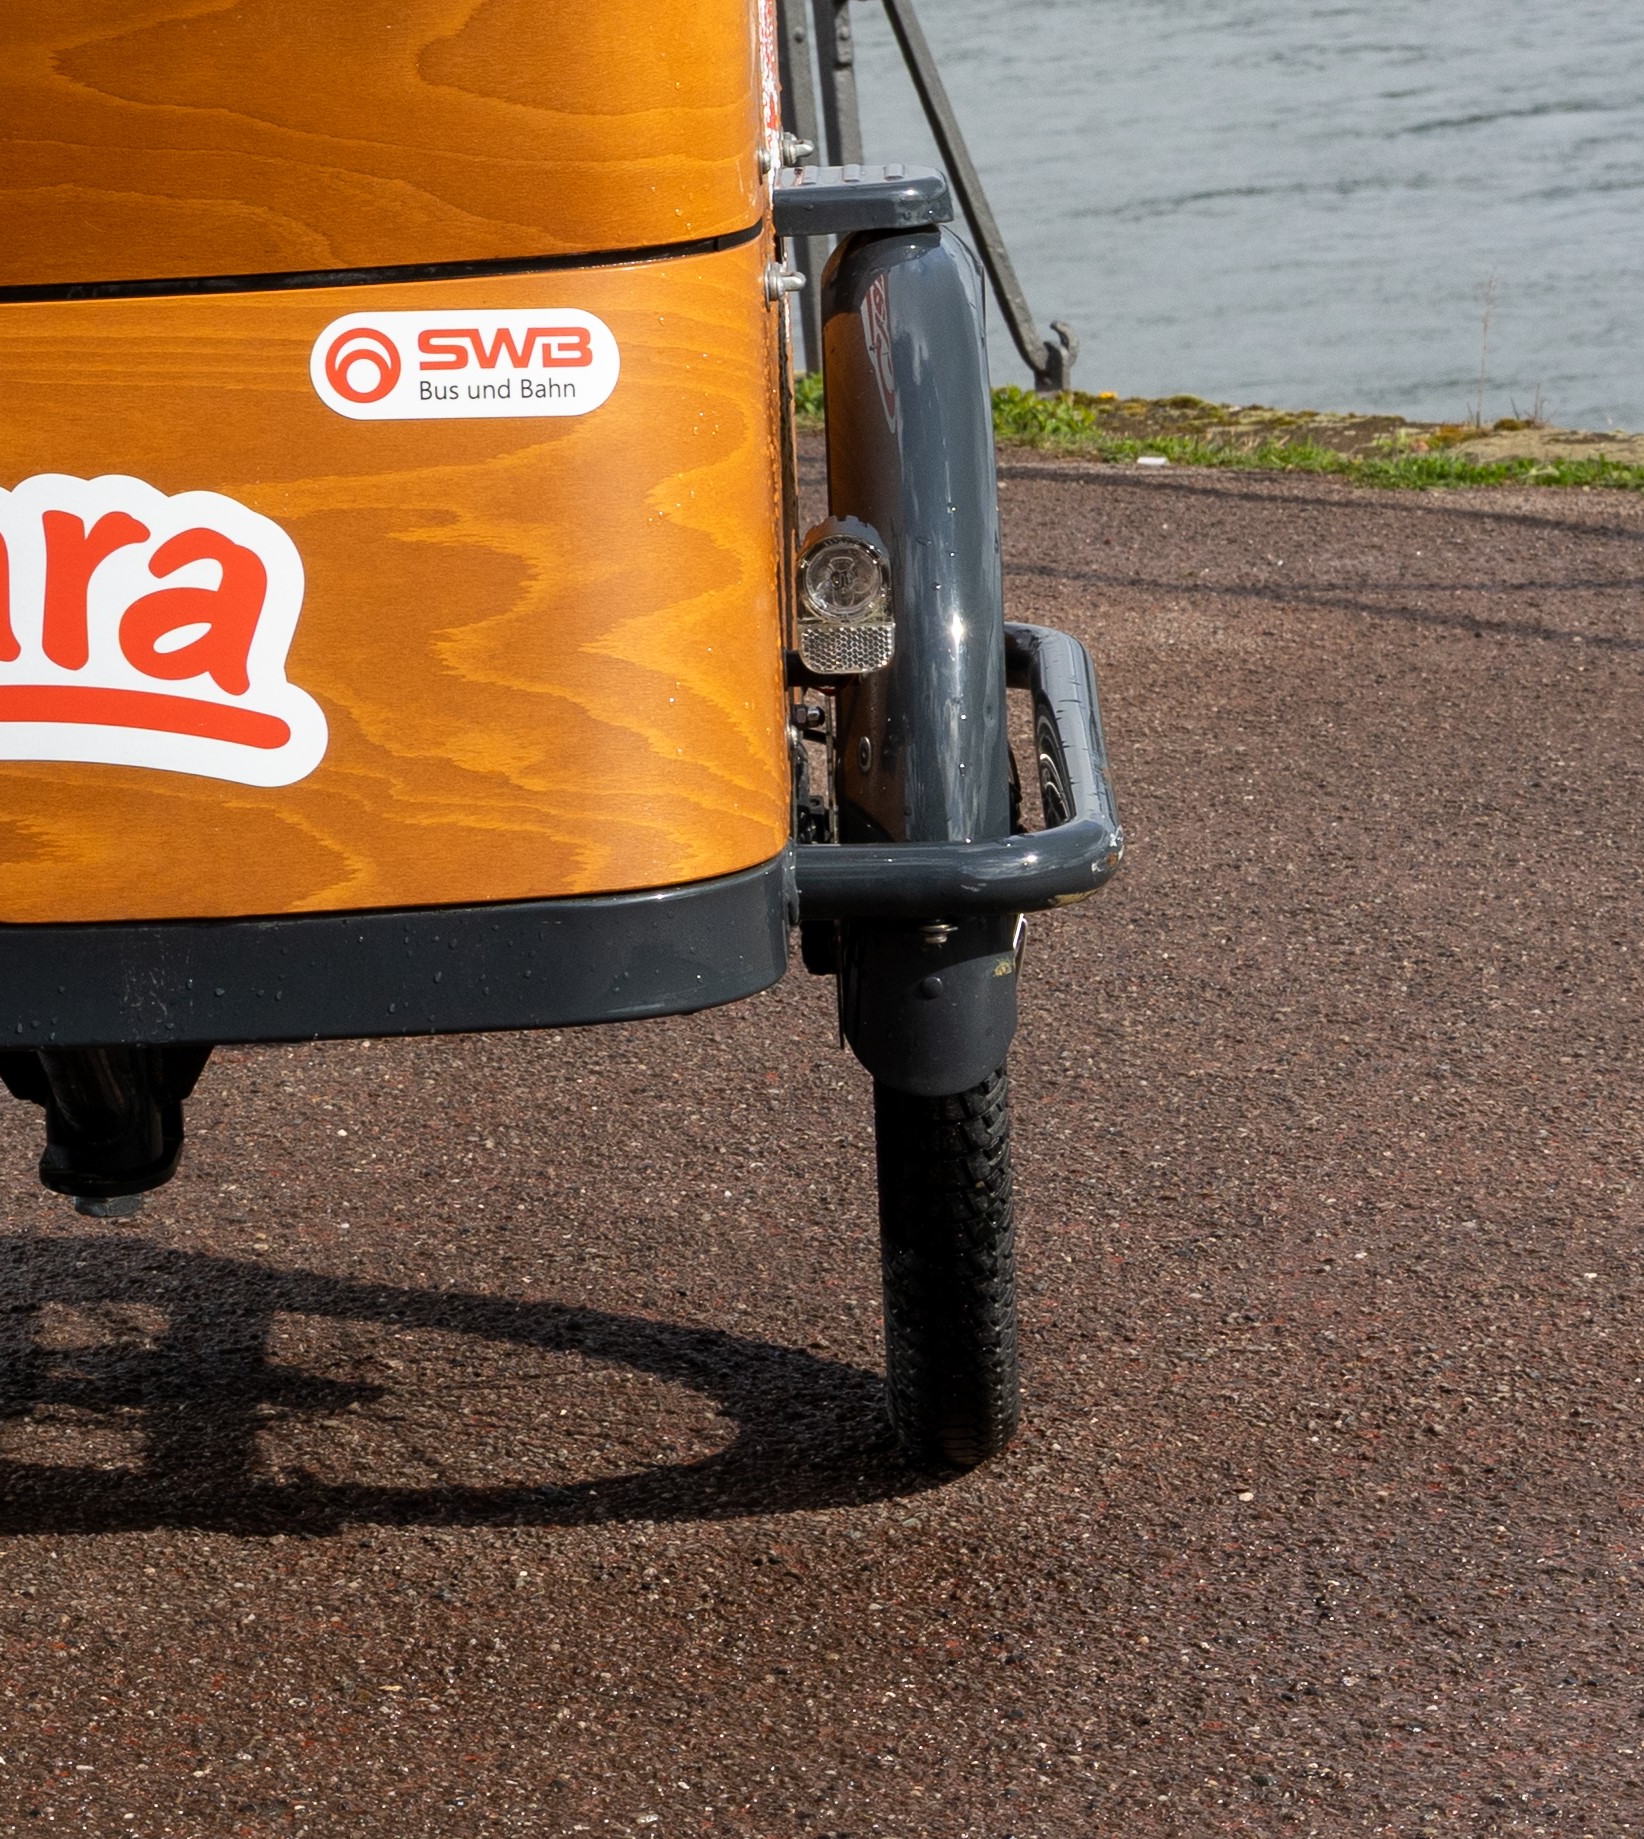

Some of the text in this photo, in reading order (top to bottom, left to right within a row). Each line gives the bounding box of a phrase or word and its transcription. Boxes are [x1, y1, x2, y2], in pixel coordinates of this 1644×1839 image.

[418, 327, 593, 371] SWB
[419, 377, 576, 401] Bus und Bahn
